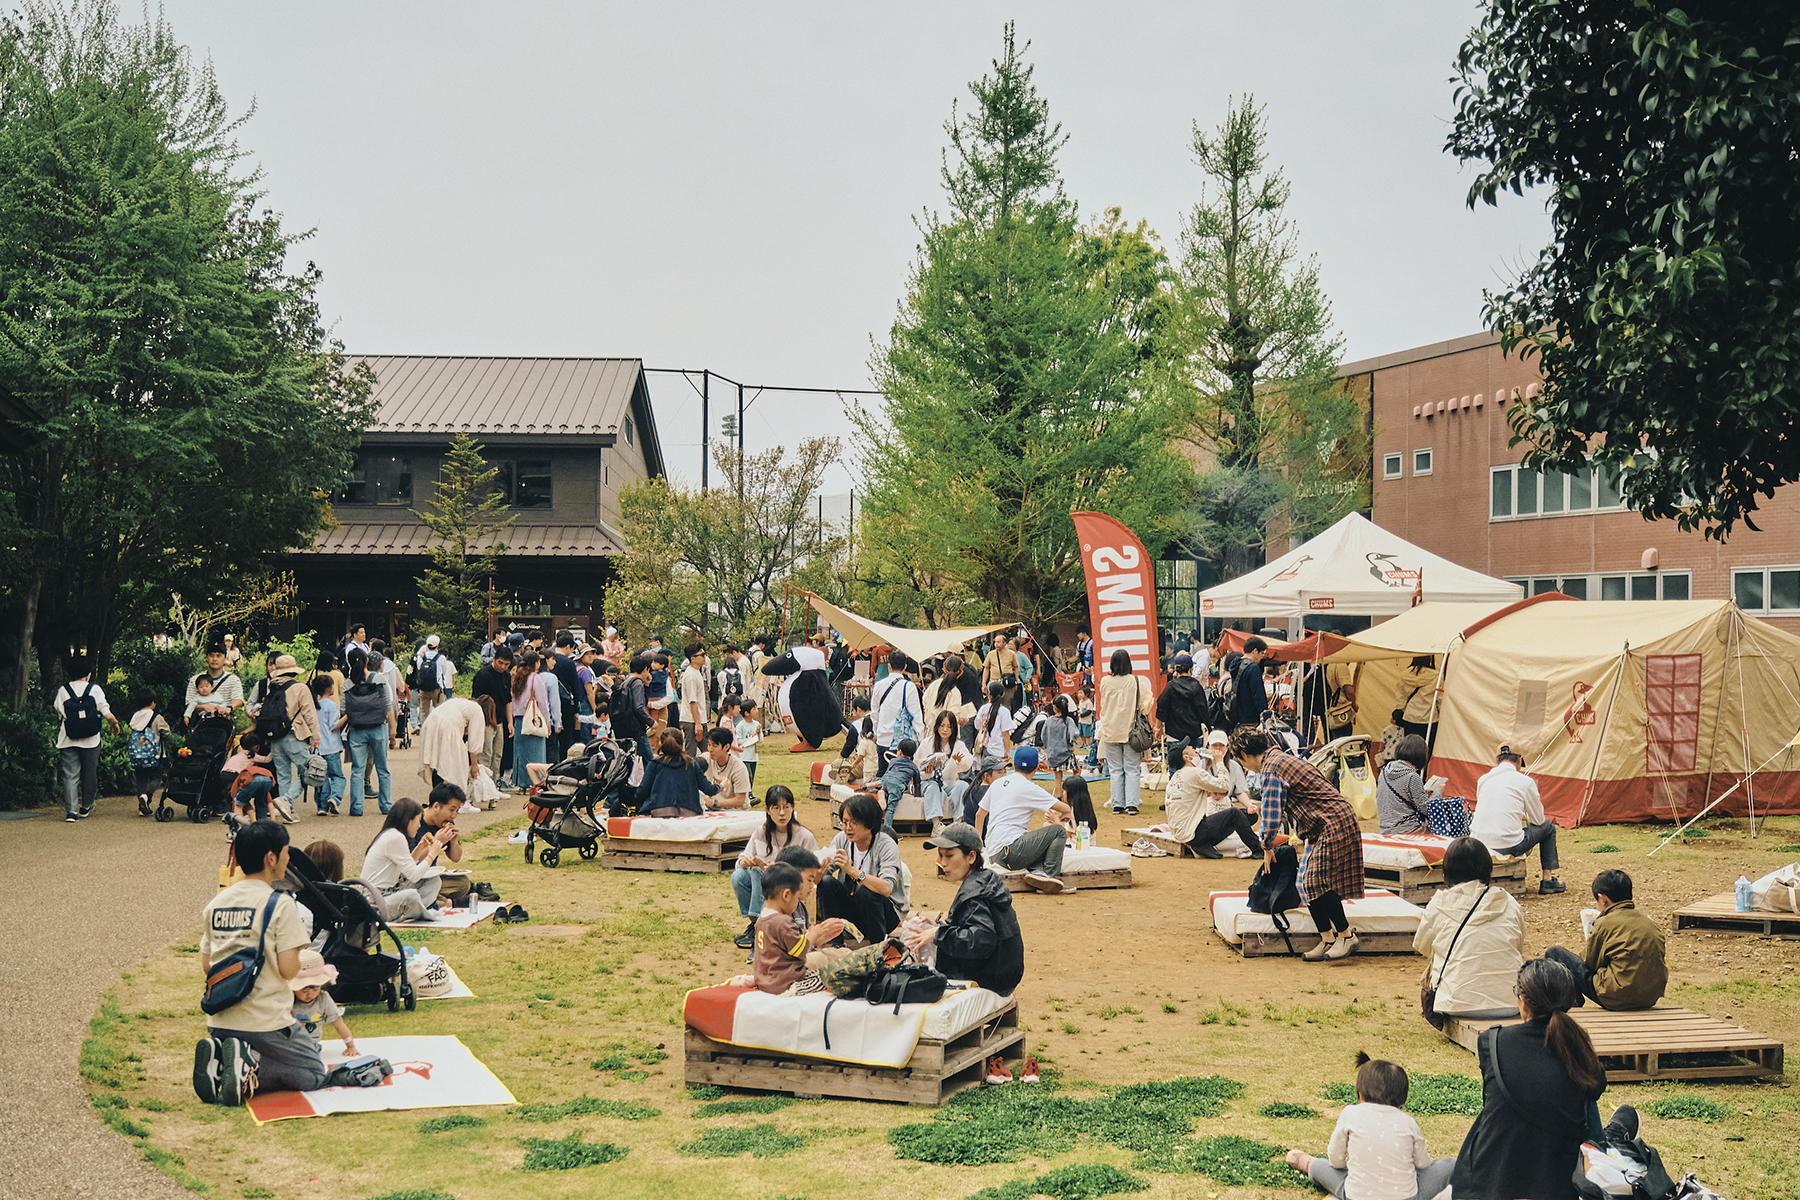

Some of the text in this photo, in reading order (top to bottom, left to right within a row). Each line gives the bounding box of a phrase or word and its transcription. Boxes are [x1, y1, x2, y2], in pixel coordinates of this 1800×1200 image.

[1310, 599, 1333, 608] CHUMS
[213, 910, 252, 928] CHUMS
[758, 930, 764, 949] S
